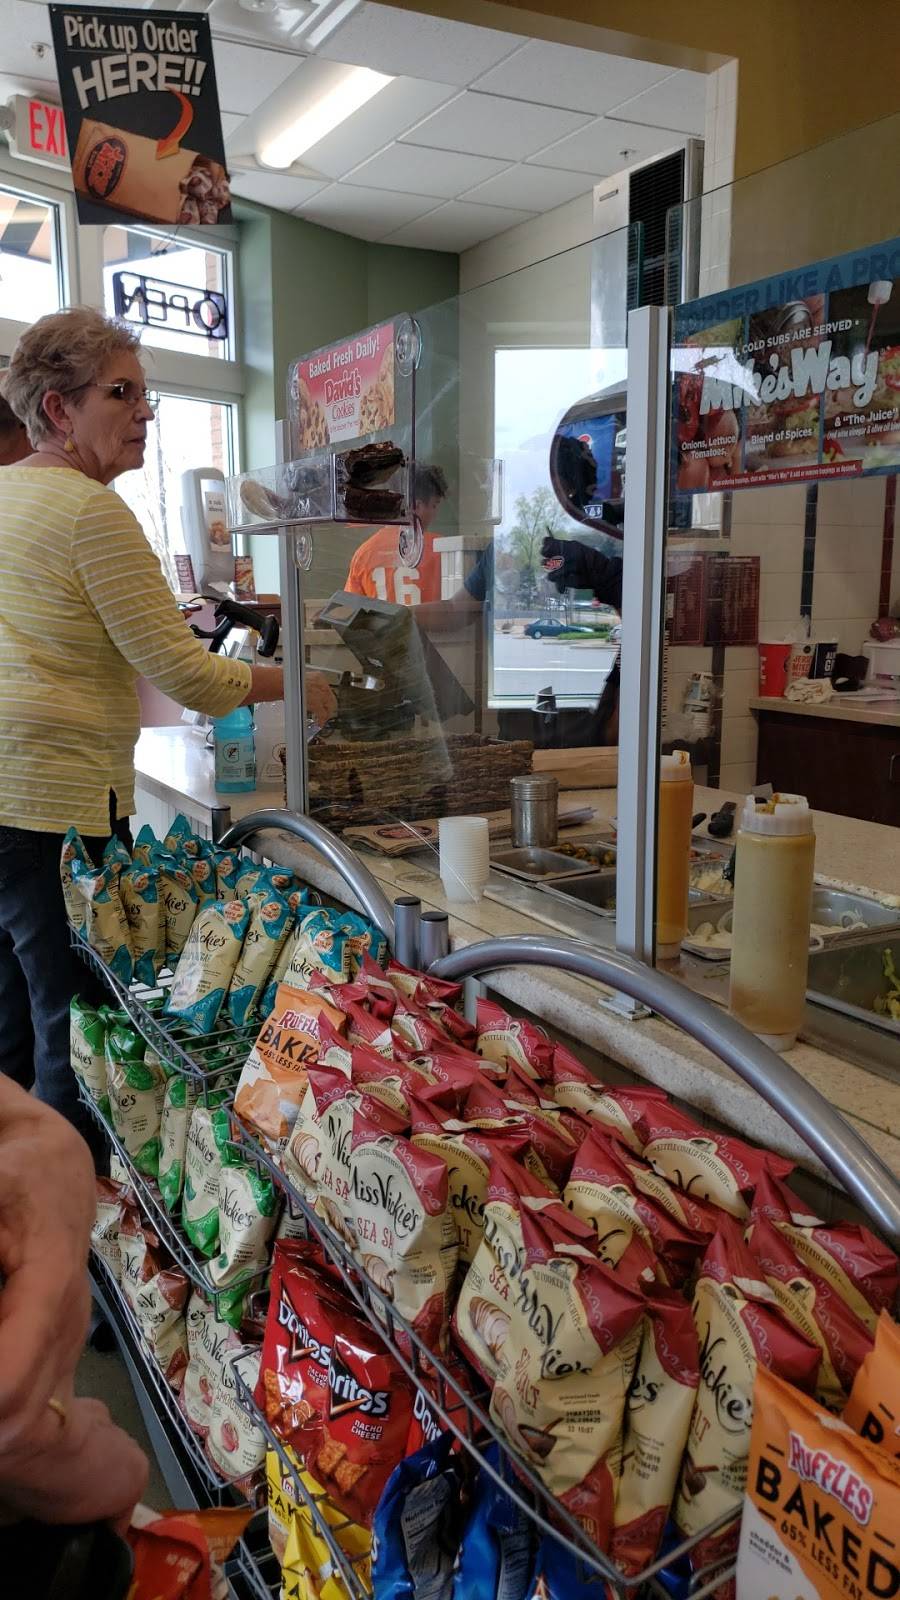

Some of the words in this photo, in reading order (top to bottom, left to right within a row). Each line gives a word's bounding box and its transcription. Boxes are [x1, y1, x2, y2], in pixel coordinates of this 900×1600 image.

[63, 15, 109, 49] Pick
[109, 23, 139, 54] up
[141, 19, 199, 53] Order
[71, 53, 208, 111] HERE!!
[29, 101, 66, 157] EXI
[766, 269, 819, 304] LIKE
[824, 264, 844, 292] A
[309, 358, 331, 378] Baked
[333, 350, 354, 370] Fresh
[356, 334, 380, 359] Daily!
[742, 339, 766, 354] COLD
[767, 334, 791, 348] SUBS
[791, 328, 812, 341] ARE
[813, 319, 853, 337] SERVED
[325, 368, 361, 407] David's
[790, 340, 879, 408] Way
[751, 432, 774, 445] Blend
[775, 430, 785, 441] of
[785, 427, 813, 442] Spices
[834, 417, 841, 428] &
[681, 440, 708, 451] Onions,
[371, 566, 422, 606] 16
[277, 1009, 321, 1041] RUFFLE
[275, 1055, 293, 1069] LESS
[373, 1171, 419, 1239] Vickie's
[357, 1217, 377, 1245] SEA
[351, 1425, 382, 1440] CHEESE
[354, 1419, 383, 1433] NACHO
[788, 1431, 873, 1526] RUFFLES
[750, 1531, 783, 1557] cheddar
[755, 1456, 900, 1600] BAKED
[767, 1551, 793, 1575] cream
[781, 1520, 807, 1548] 65%
[811, 1542, 839, 1580] LESS
